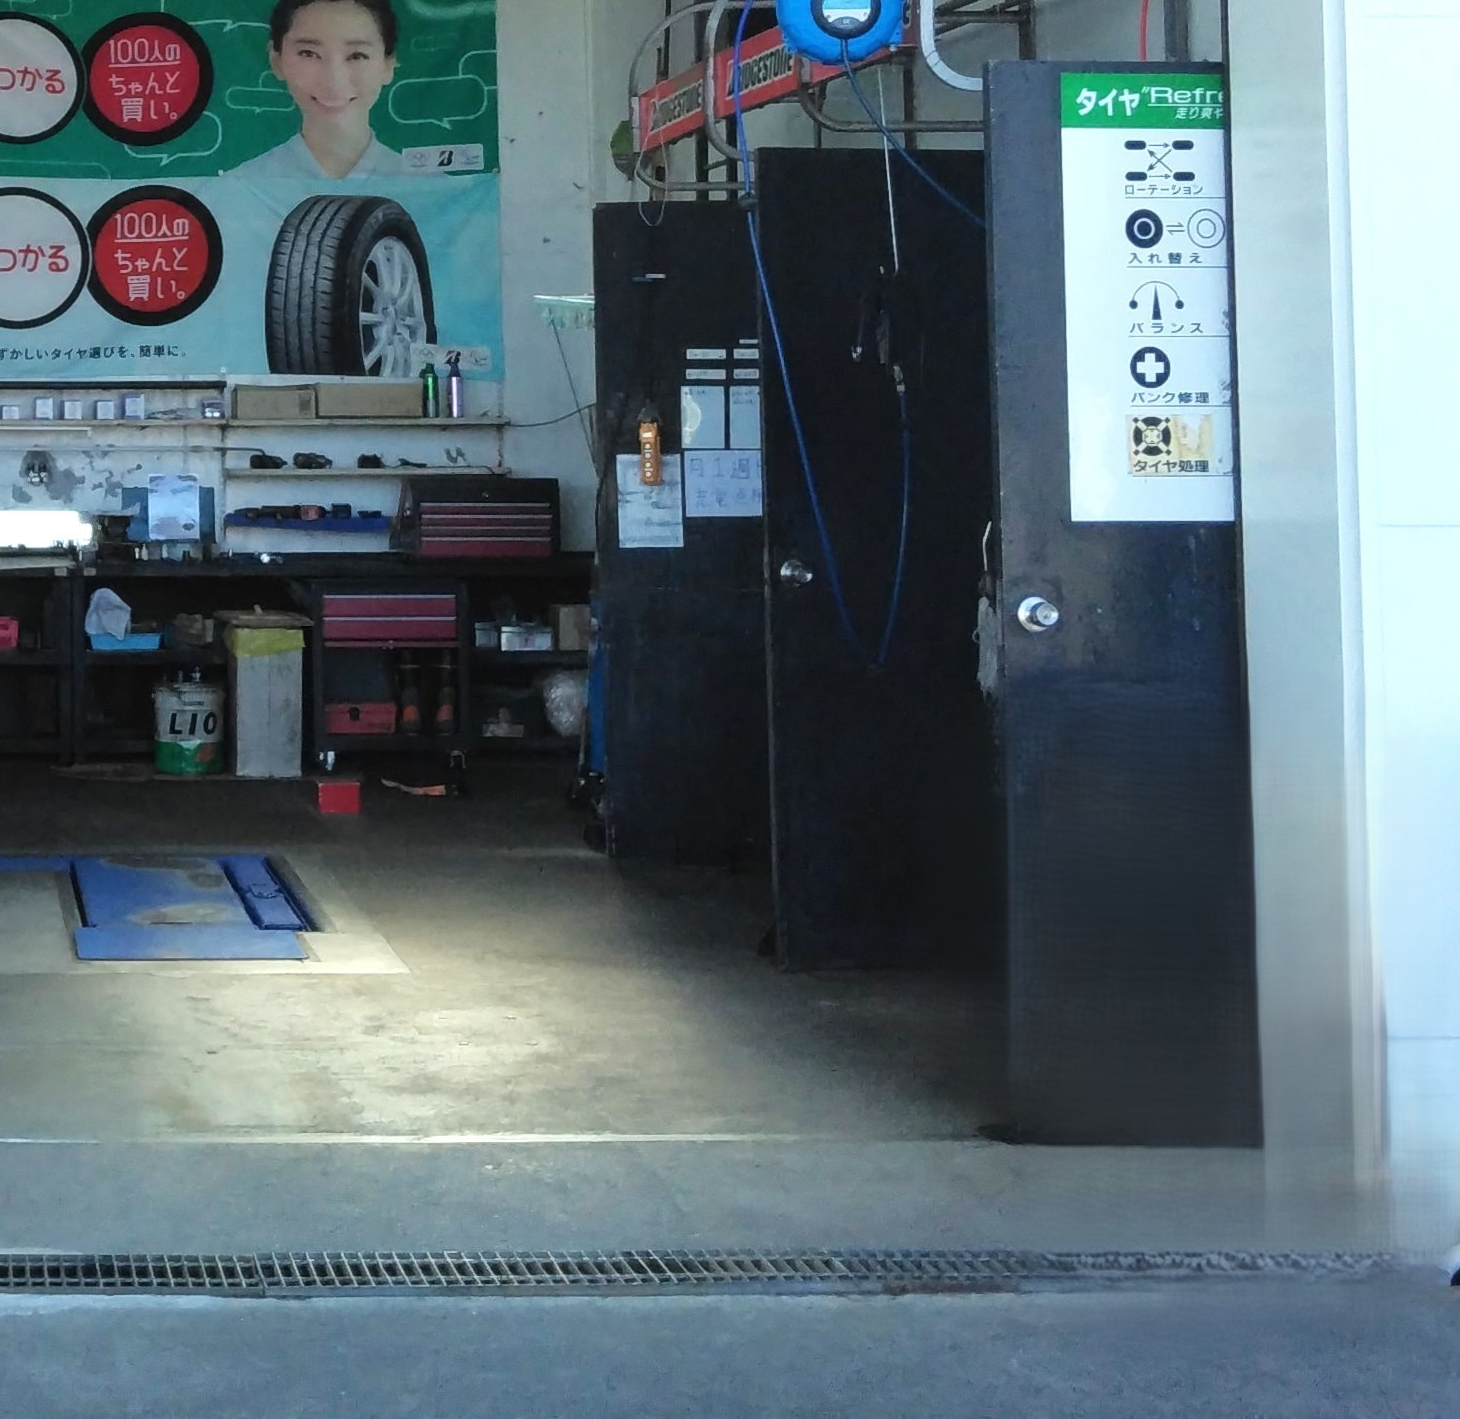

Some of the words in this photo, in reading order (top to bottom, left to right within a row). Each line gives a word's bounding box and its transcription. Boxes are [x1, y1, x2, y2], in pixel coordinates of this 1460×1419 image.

[108, 38, 181, 63] 100人の
[108, 71, 181, 96] ちゃんと
[726, 45, 793, 98] IDGESTONE
[121, 97, 178, 123] 買い。
[1076, 87, 1140, 117] タイヤ
[1124, 184, 1204, 196] ローテーション
[114, 212, 189, 238] 100人の
[114, 247, 189, 274] ちゃんと
[1128, 252, 1203, 265] 入れ替え
[126, 274, 187, 301] 買い。
[1129, 322, 1204, 334] バランス
[1132, 459, 1210, 473] タイヤ処理
